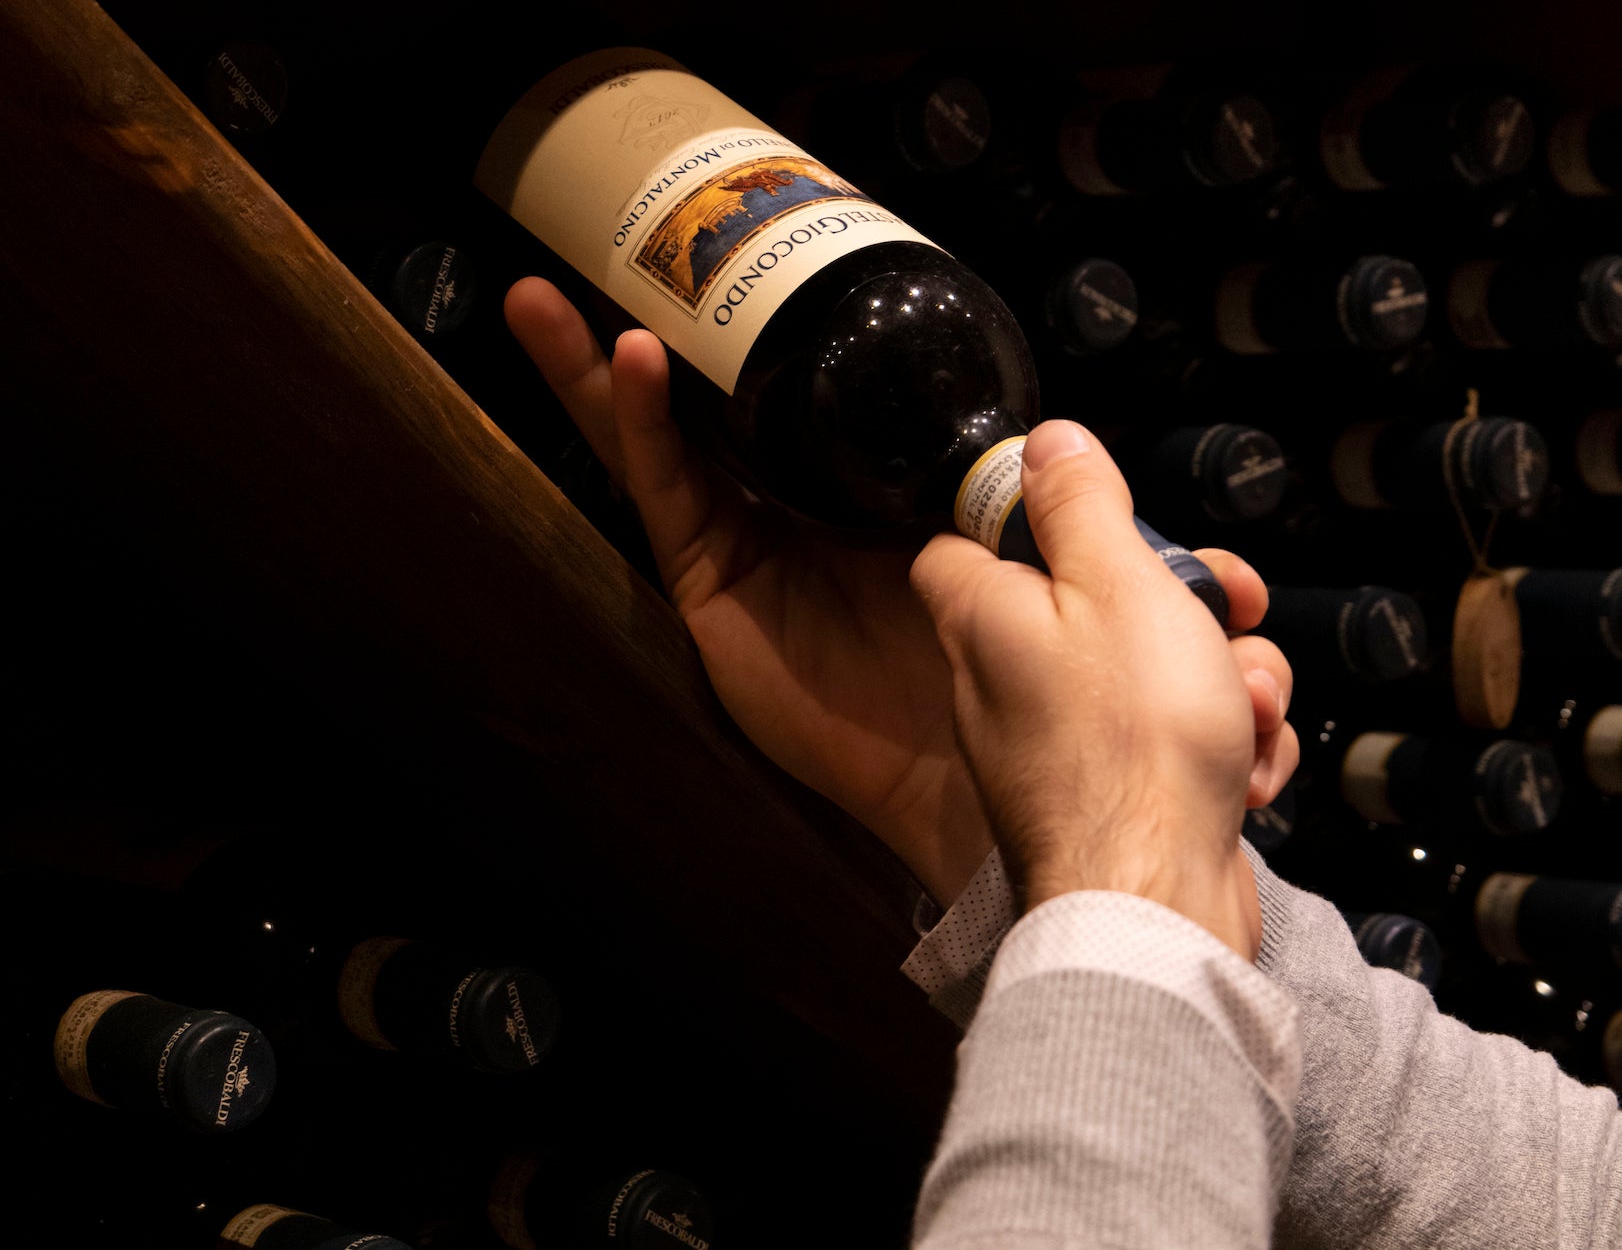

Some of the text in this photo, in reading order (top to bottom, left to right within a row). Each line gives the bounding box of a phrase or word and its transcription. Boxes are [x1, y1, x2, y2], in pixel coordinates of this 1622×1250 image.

[218, 52, 278, 125] FRESCOBALDI
[613, 148, 722, 247] MONTALCINO
[424, 247, 456, 334] FRESCOBALDI
[506, 982, 540, 1066] FRESCOBALDI
[215, 1030, 250, 1127] FRESCOBALDI
